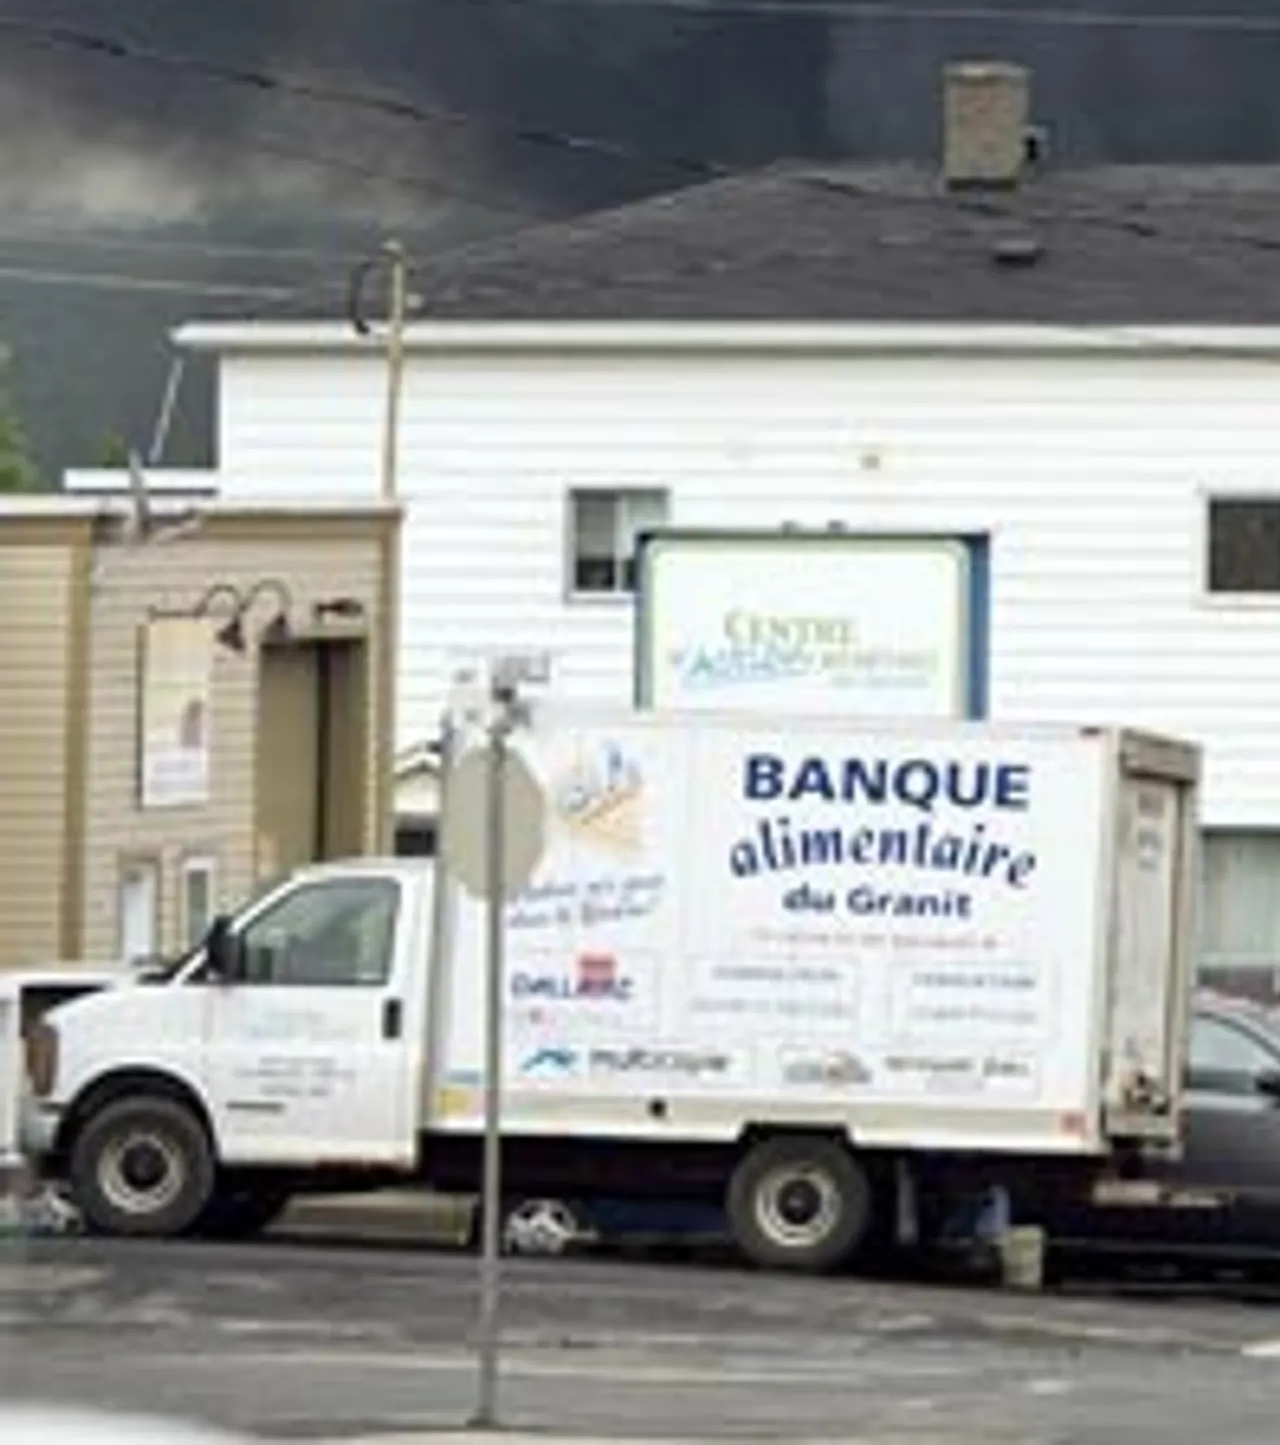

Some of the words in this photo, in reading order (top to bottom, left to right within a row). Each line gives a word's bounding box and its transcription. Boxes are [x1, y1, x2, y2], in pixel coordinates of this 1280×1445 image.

[743, 752, 1031, 812] BANQUE
[730, 816, 1036, 888] alimentaire
[782, 881, 836, 912] du
[846, 884, 972, 917] Granit
